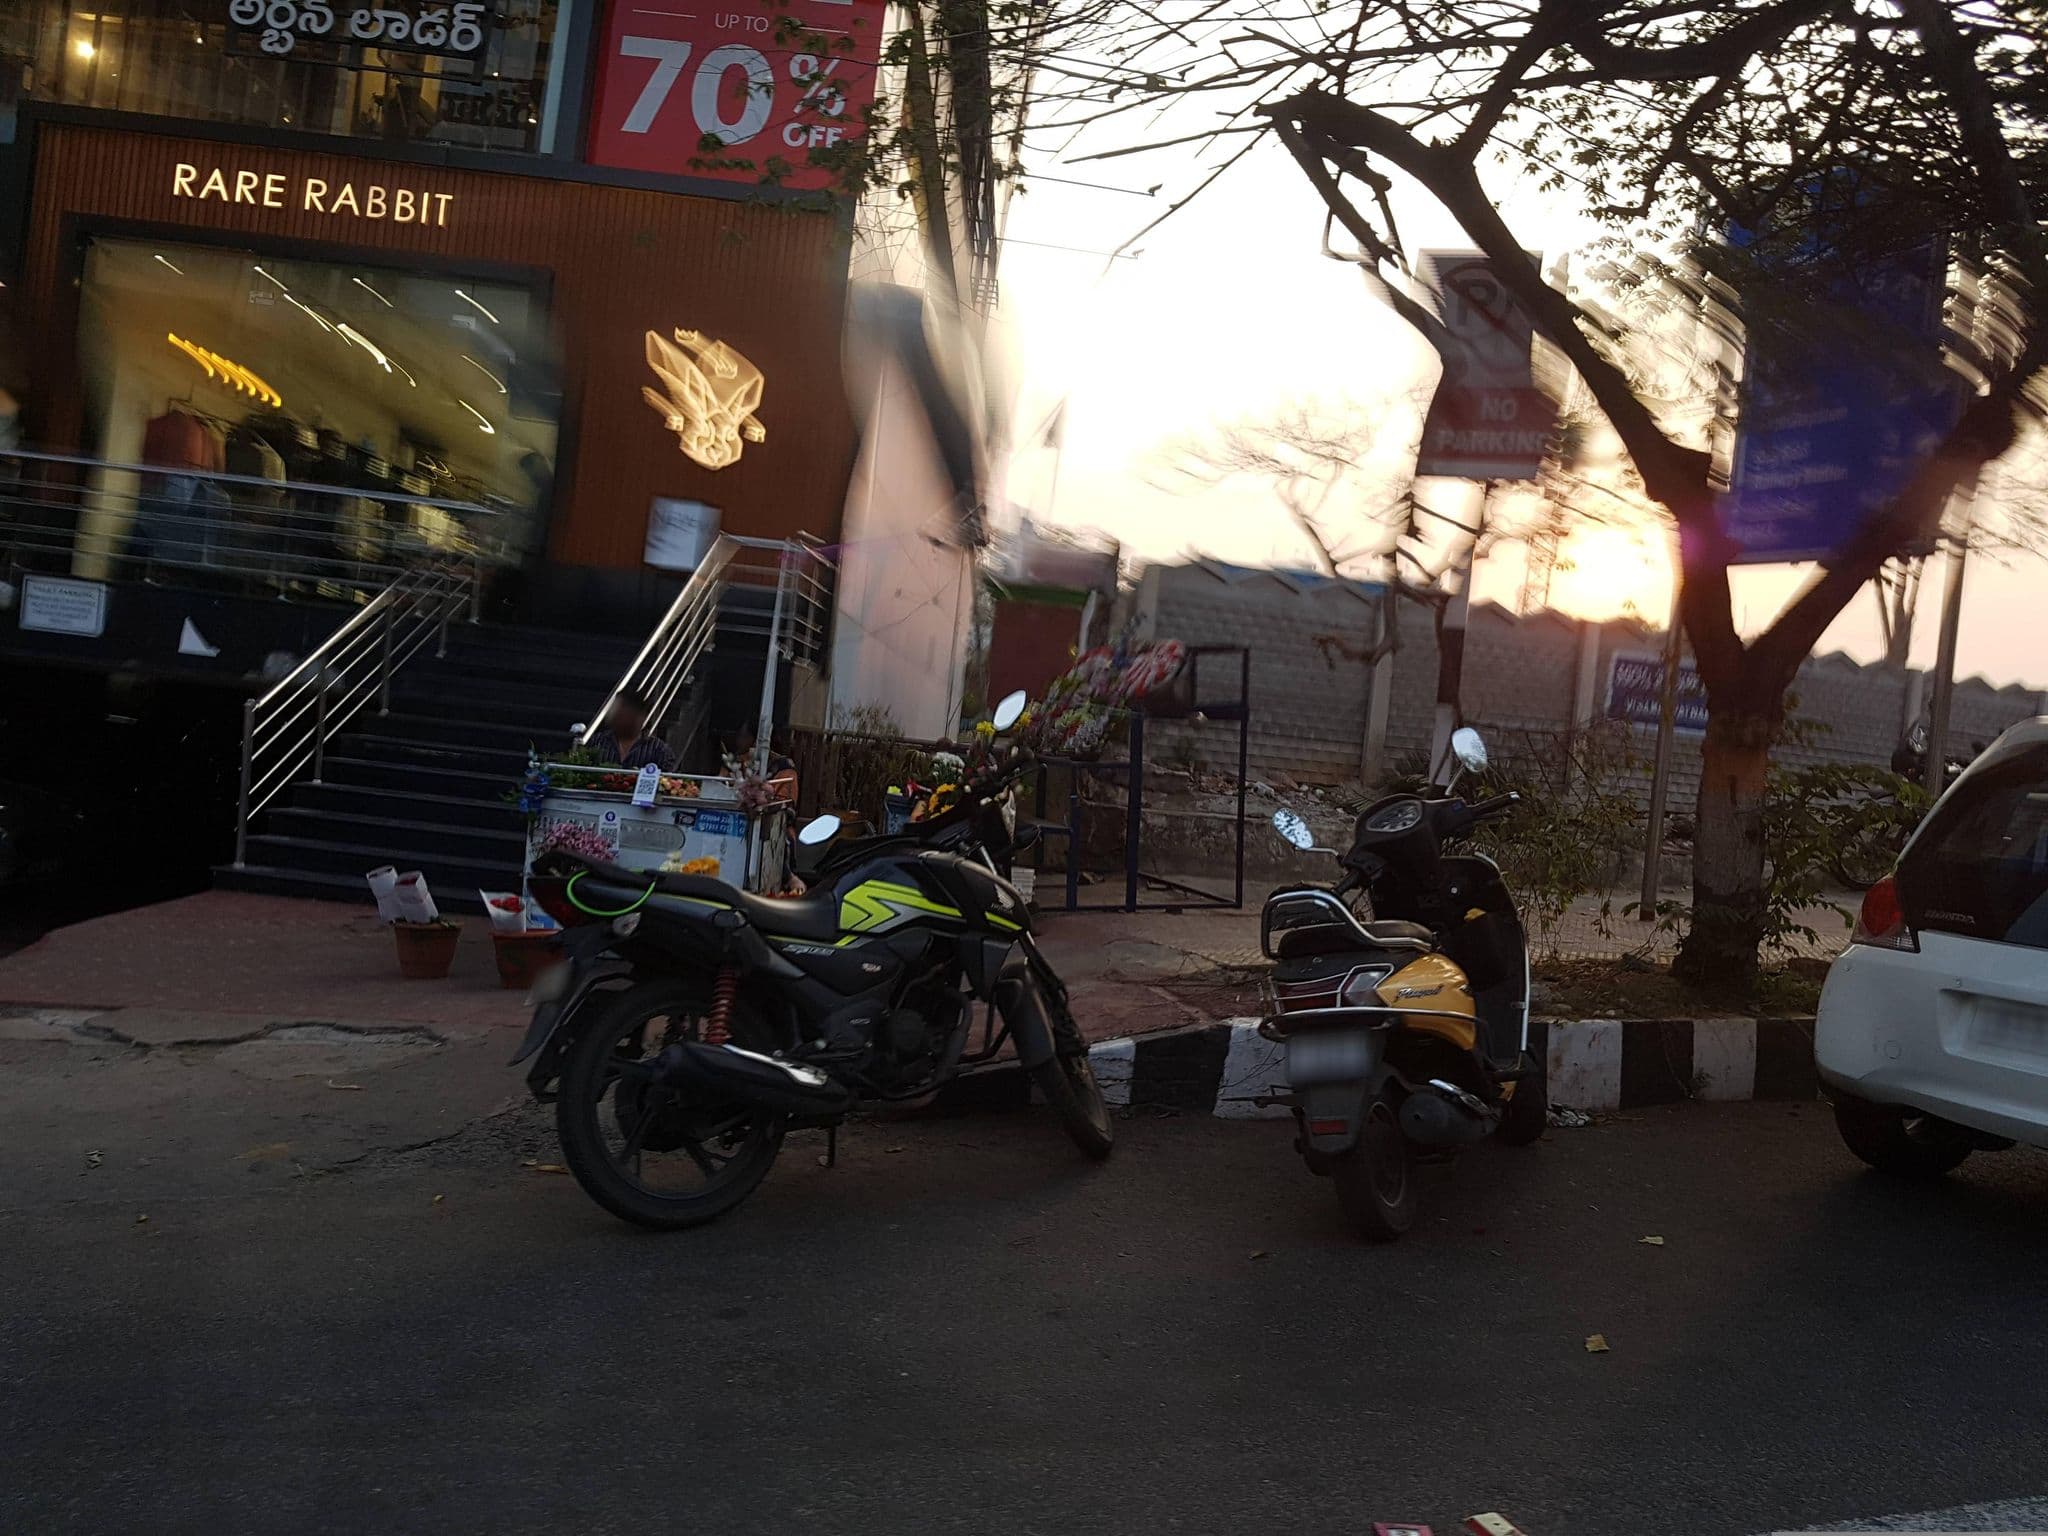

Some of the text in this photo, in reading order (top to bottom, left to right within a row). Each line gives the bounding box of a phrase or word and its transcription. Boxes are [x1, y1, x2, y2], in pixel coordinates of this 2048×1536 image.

[714, 13, 769, 33] UP TO
[172, 162, 455, 227] RARE RABBIT
[1480, 397, 1517, 422] NO
